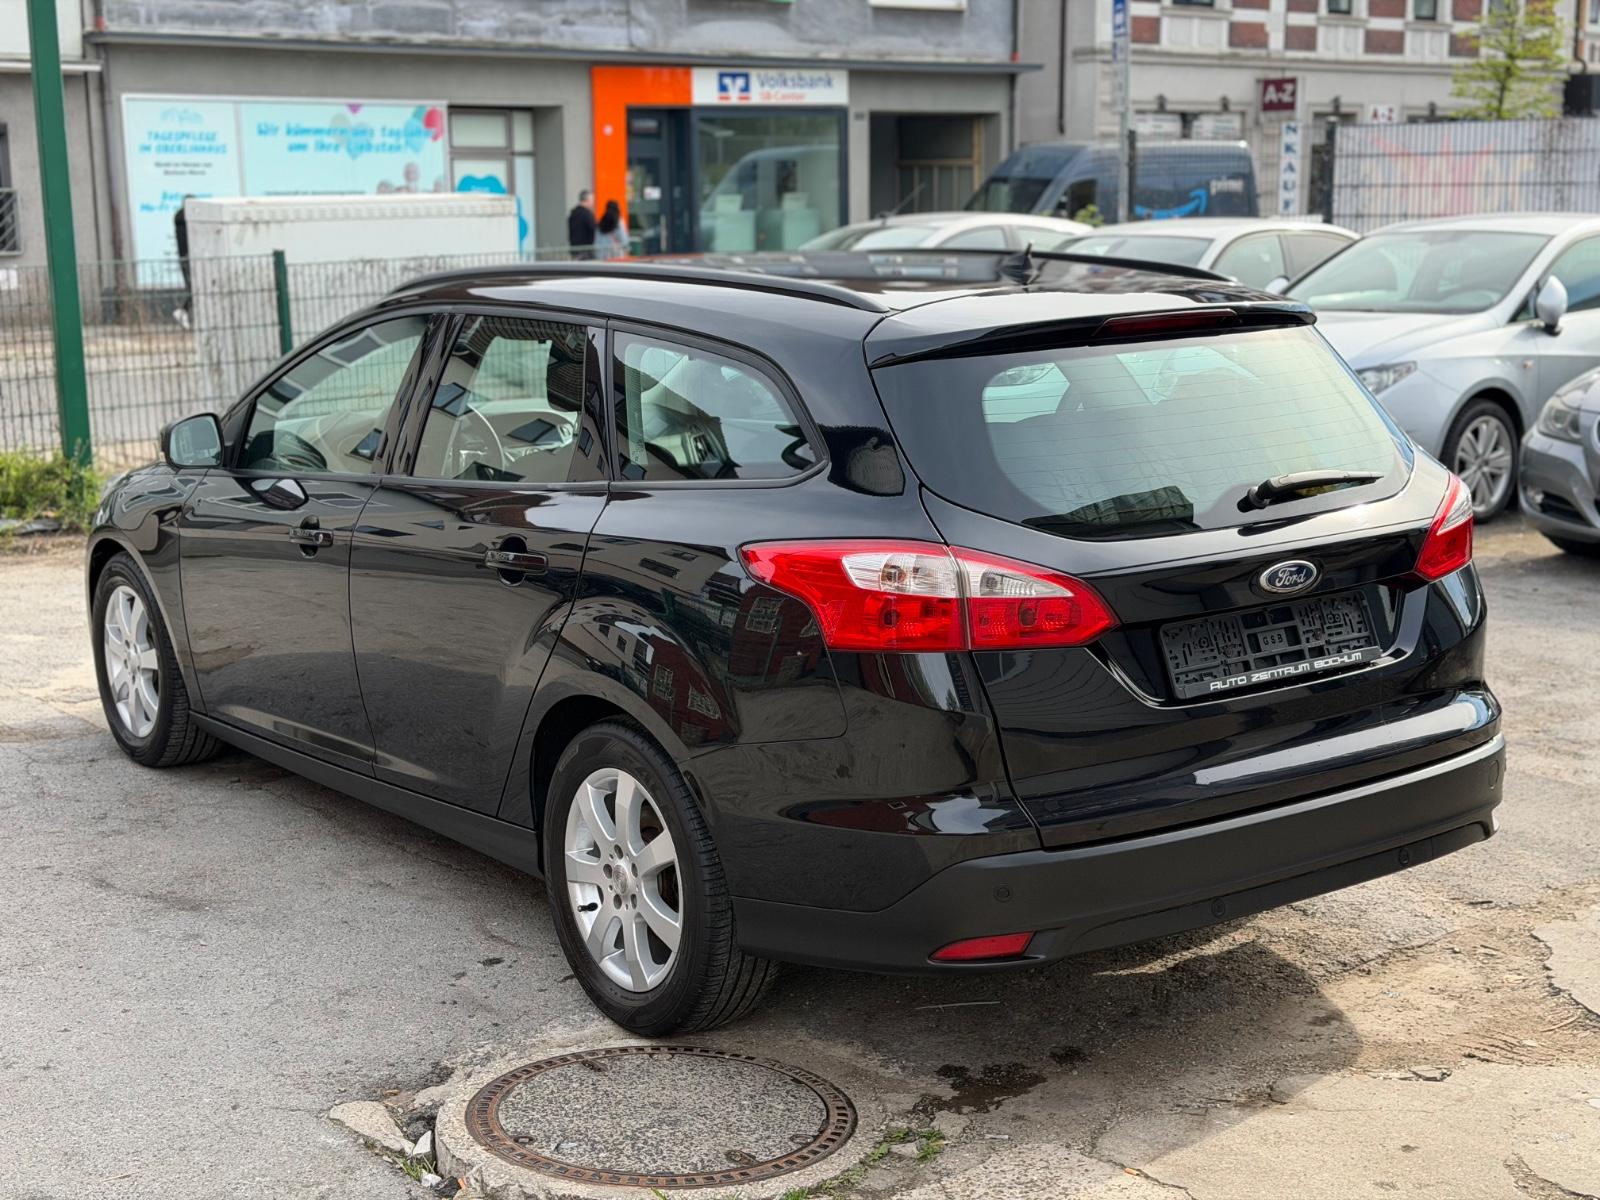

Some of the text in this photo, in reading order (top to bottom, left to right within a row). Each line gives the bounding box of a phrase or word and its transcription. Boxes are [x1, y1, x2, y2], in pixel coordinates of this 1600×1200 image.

[757, 71, 833, 88] Volksbank
[1264, 82, 1295, 104] A-Z
[1275, 566, 1307, 587] Ford
[1210, 652, 1362, 691] AUTO ZENTRUM BOCHUM
